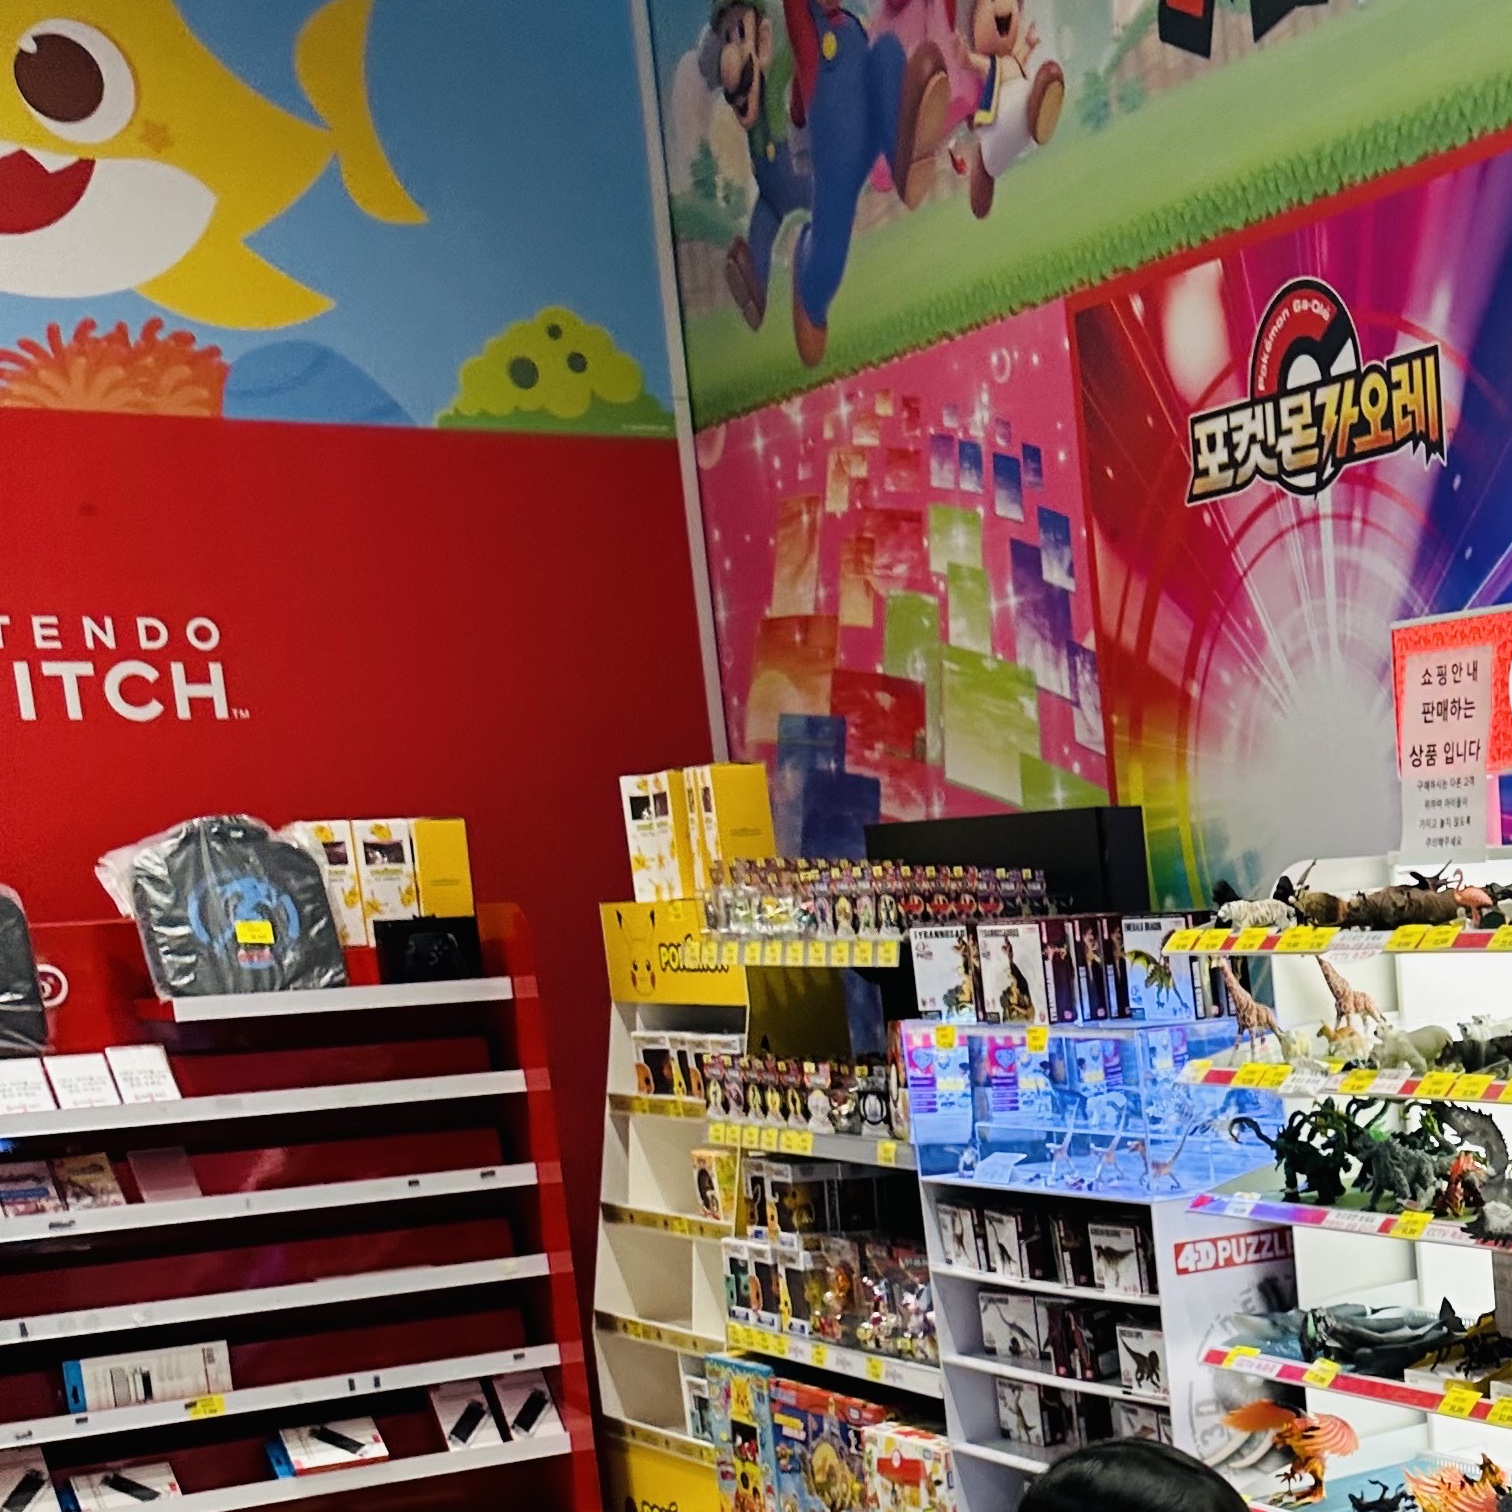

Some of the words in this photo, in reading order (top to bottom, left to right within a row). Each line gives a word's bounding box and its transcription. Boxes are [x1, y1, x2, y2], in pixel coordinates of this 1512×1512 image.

[1258, 308, 1290, 391] Pokémon
[1192, 394, 1319, 496] 포켓몬
[1314, 354, 1440, 458] 가오레
[1420, 659, 1479, 687] 쇼핑안내
[1421, 696, 1476, 724] 판매하는
[1409, 744, 1438, 768] 상품
[1443, 738, 1481, 765] 입니다
